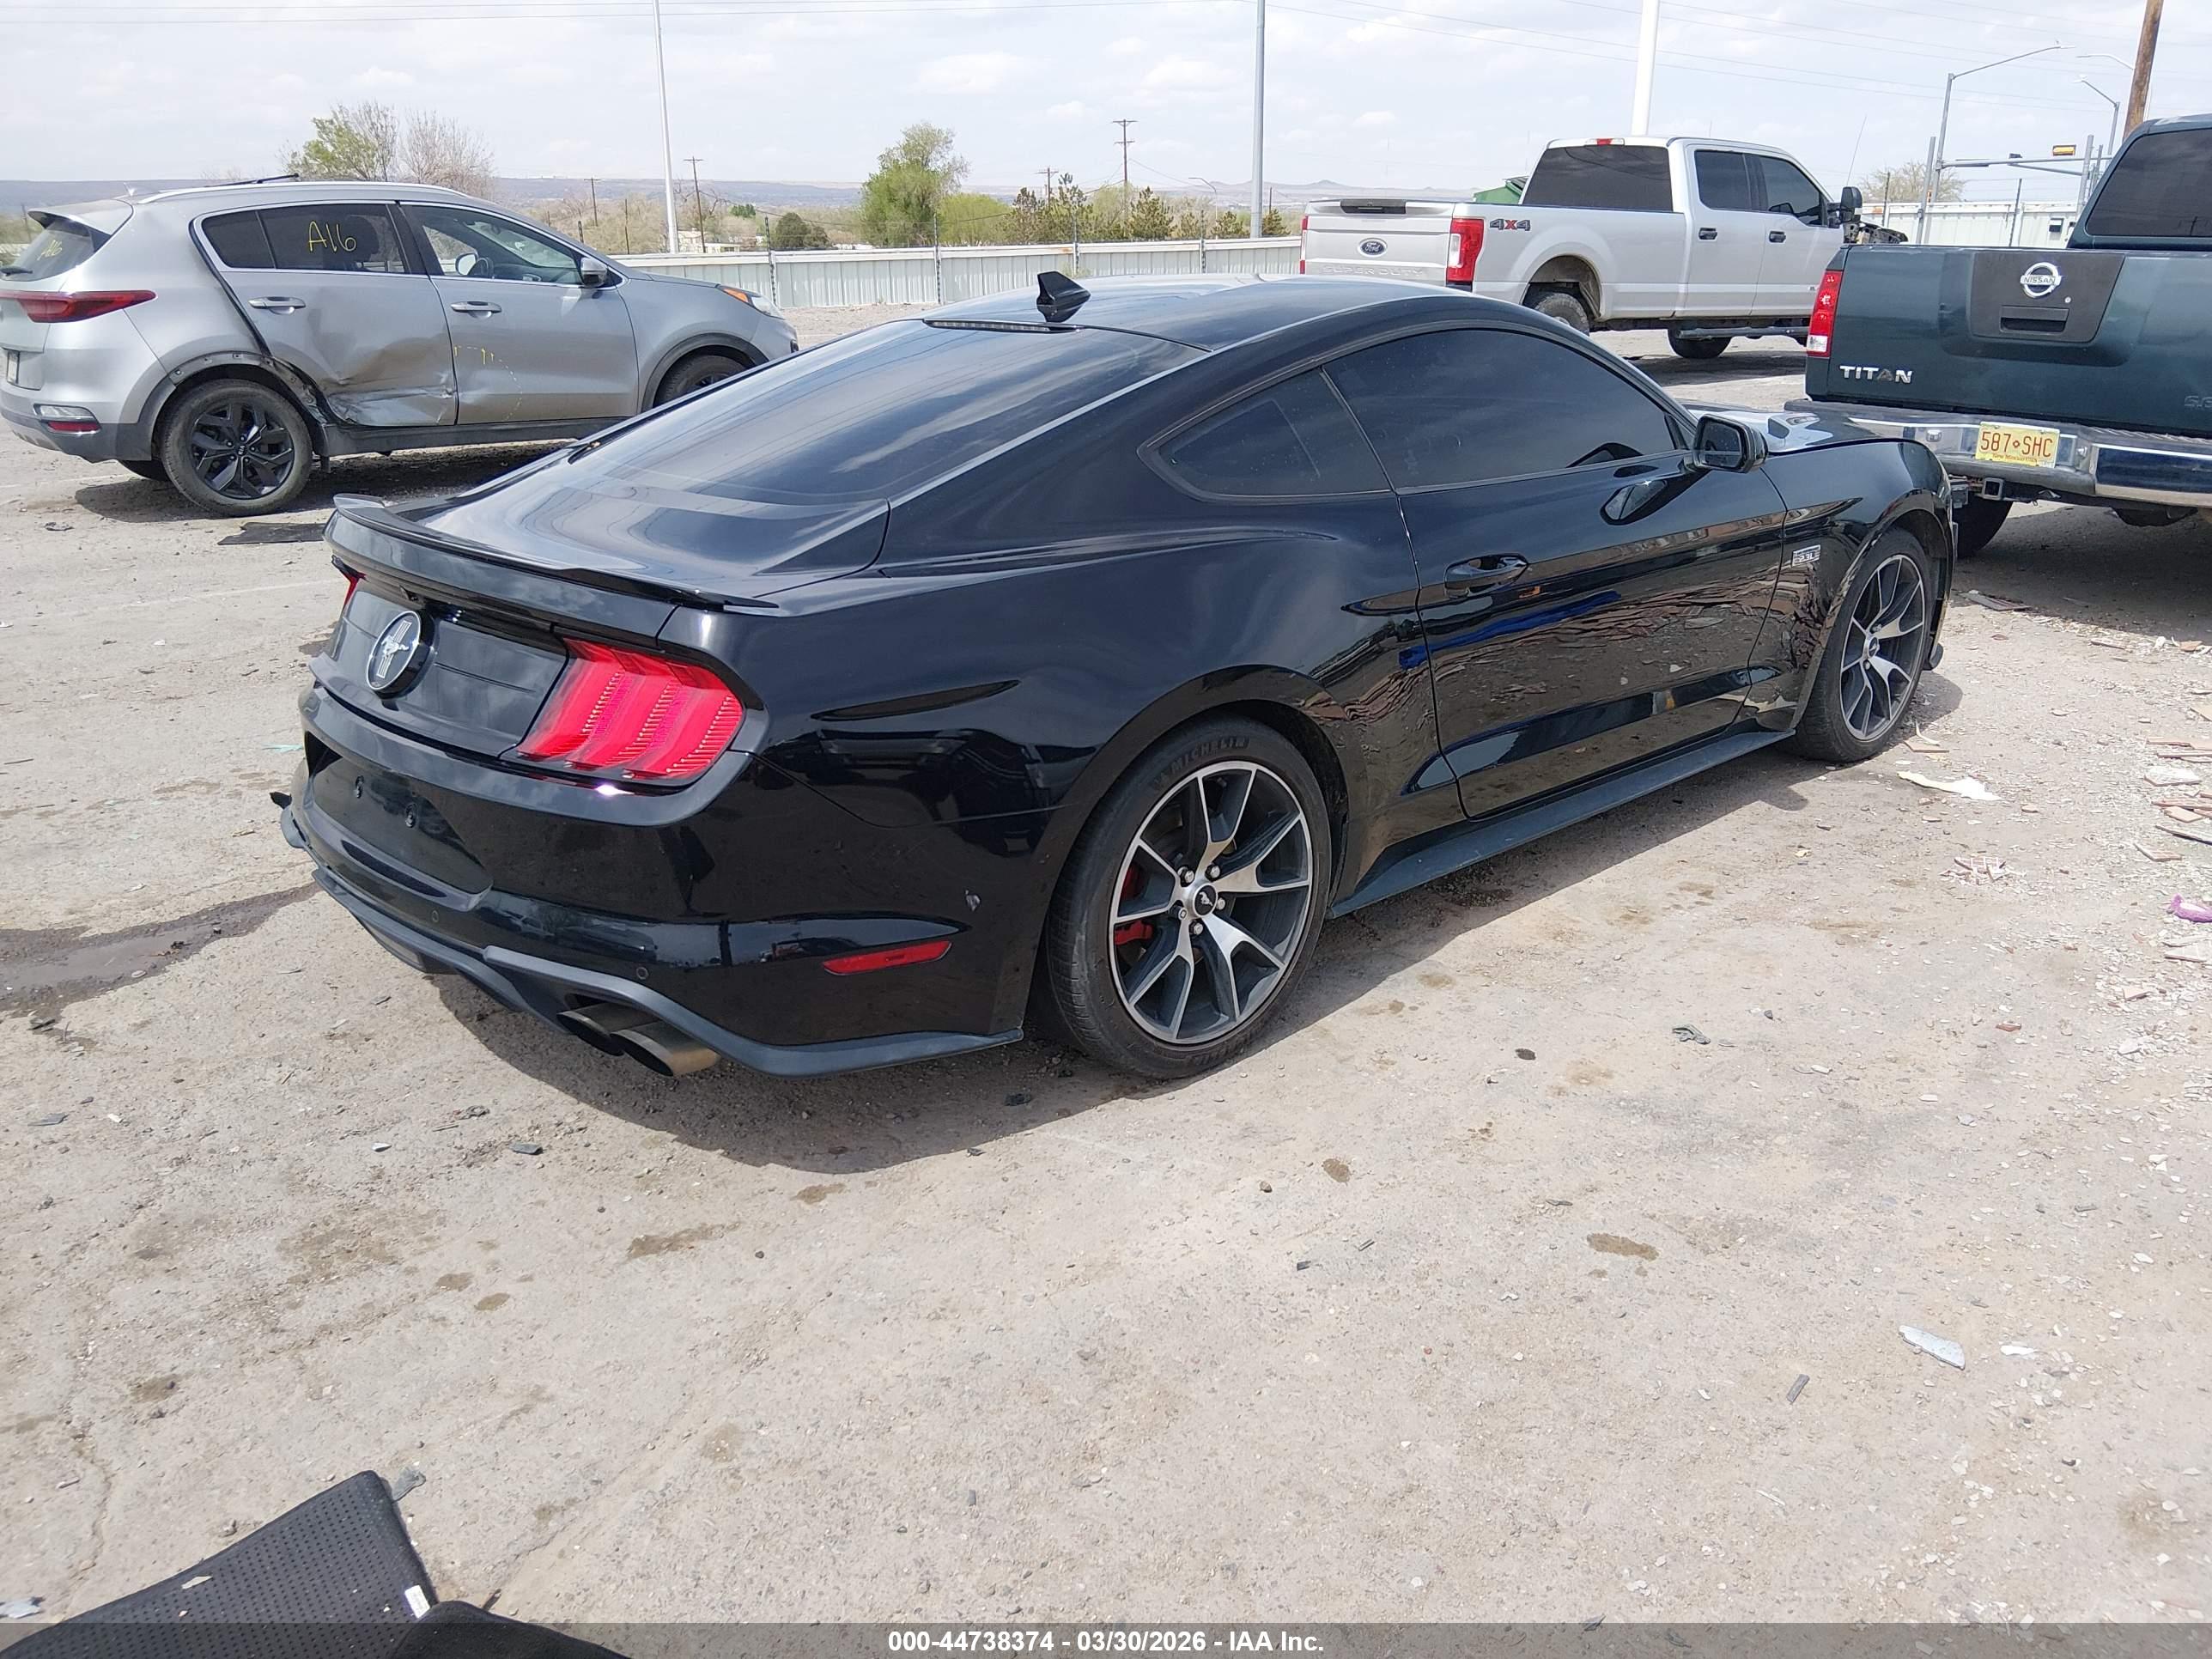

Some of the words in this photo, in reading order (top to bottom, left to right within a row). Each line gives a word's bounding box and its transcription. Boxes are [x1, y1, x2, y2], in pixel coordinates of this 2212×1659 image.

[308, 221, 357, 252] A16
[1322, 266, 1375, 276] SUPER
[1379, 268, 1424, 277] DUTY
[2024, 276, 2057, 284] NISSAN
[1839, 365, 1914, 384] TITAN
[1980, 431, 2011, 453] 587
[2021, 435, 2053, 458] SHC
